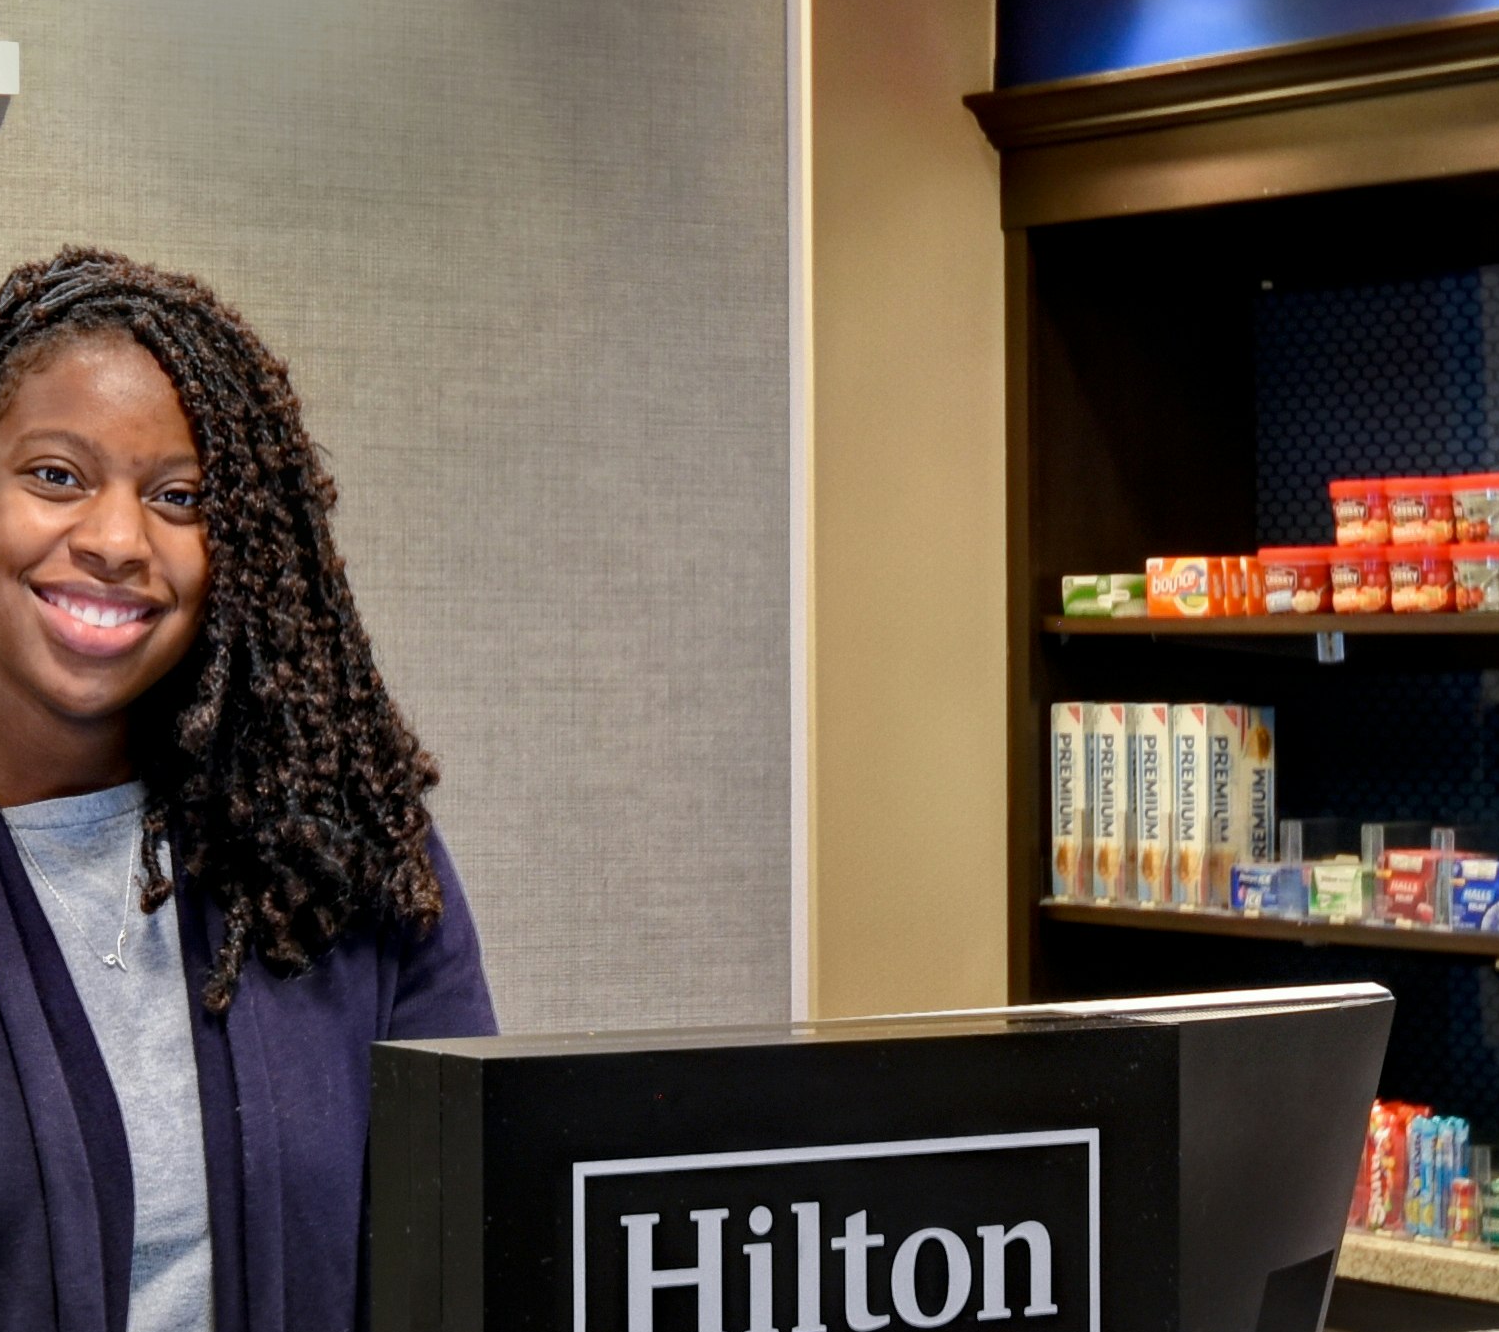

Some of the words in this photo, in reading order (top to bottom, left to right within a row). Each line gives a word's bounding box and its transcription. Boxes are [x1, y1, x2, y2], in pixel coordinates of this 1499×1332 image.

[1058, 733, 1073, 836] PREMIUM
[1101, 734, 1115, 838] PREMIUM
[1143, 734, 1157, 841] PREMIUM
[1181, 735, 1195, 842] PREMIUM
[1252, 769, 1267, 862] REMIUM
